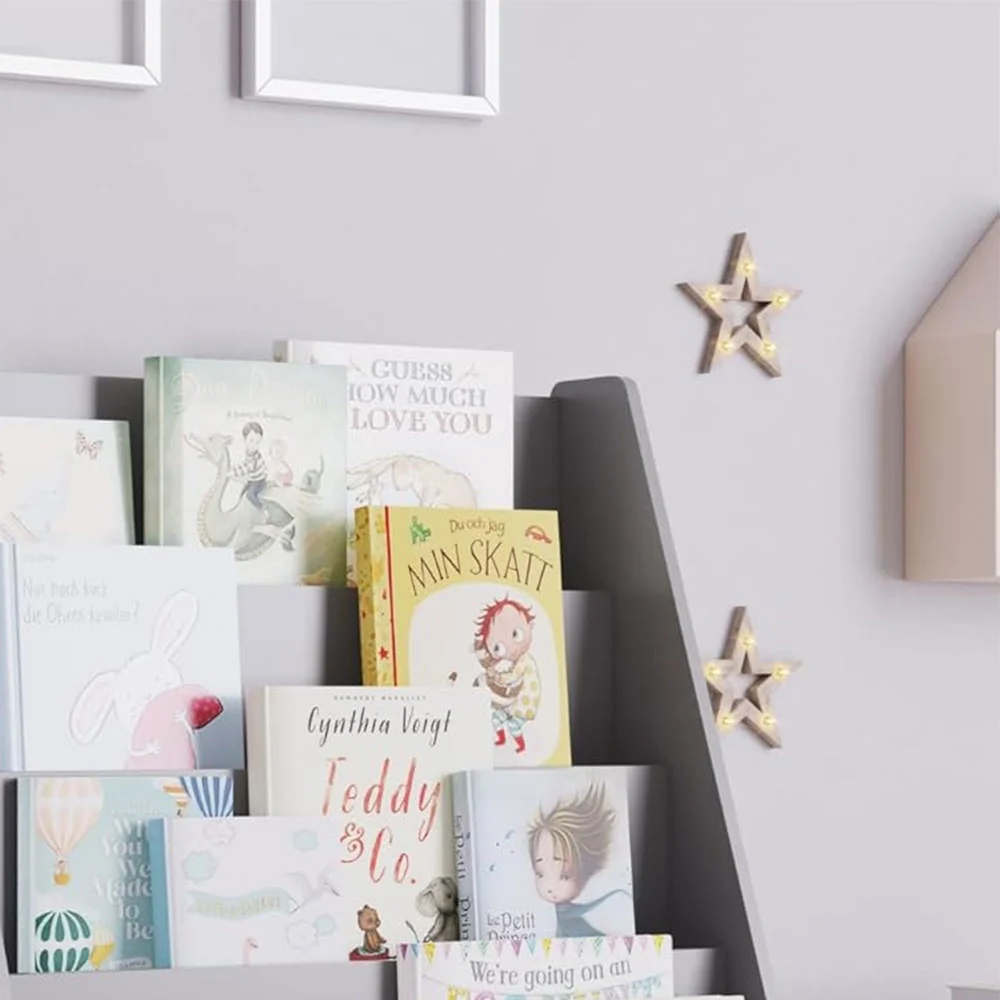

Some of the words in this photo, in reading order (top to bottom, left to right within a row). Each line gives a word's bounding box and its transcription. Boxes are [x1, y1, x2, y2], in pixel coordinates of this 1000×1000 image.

[371, 359, 453, 381] GUESS
[407, 385, 486, 408] MUCH
[352, 407, 427, 433] LOVE
[431, 411, 493, 436] YOU
[450, 519, 465, 534] Du
[466, 519, 486, 530] och
[486, 520, 505, 537] jag
[407, 544, 462, 596] MIN
[469, 539, 553, 591] SKATT
[307, 706, 391, 747] Cynthia
[402, 706, 452, 747] Voigt
[322, 757, 442, 842] Teddy
[102, 838, 143, 857] You
[340, 822, 365, 863] &
[369, 826, 417, 884] Co.
[94, 877, 153, 905] Made
[126, 921, 154, 941] Be
[500, 911, 536, 932] Petit
[470, 960, 519, 986] We're
[524, 966, 575, 991] going
[581, 963, 604, 981] on
[609, 959, 632, 977] an
